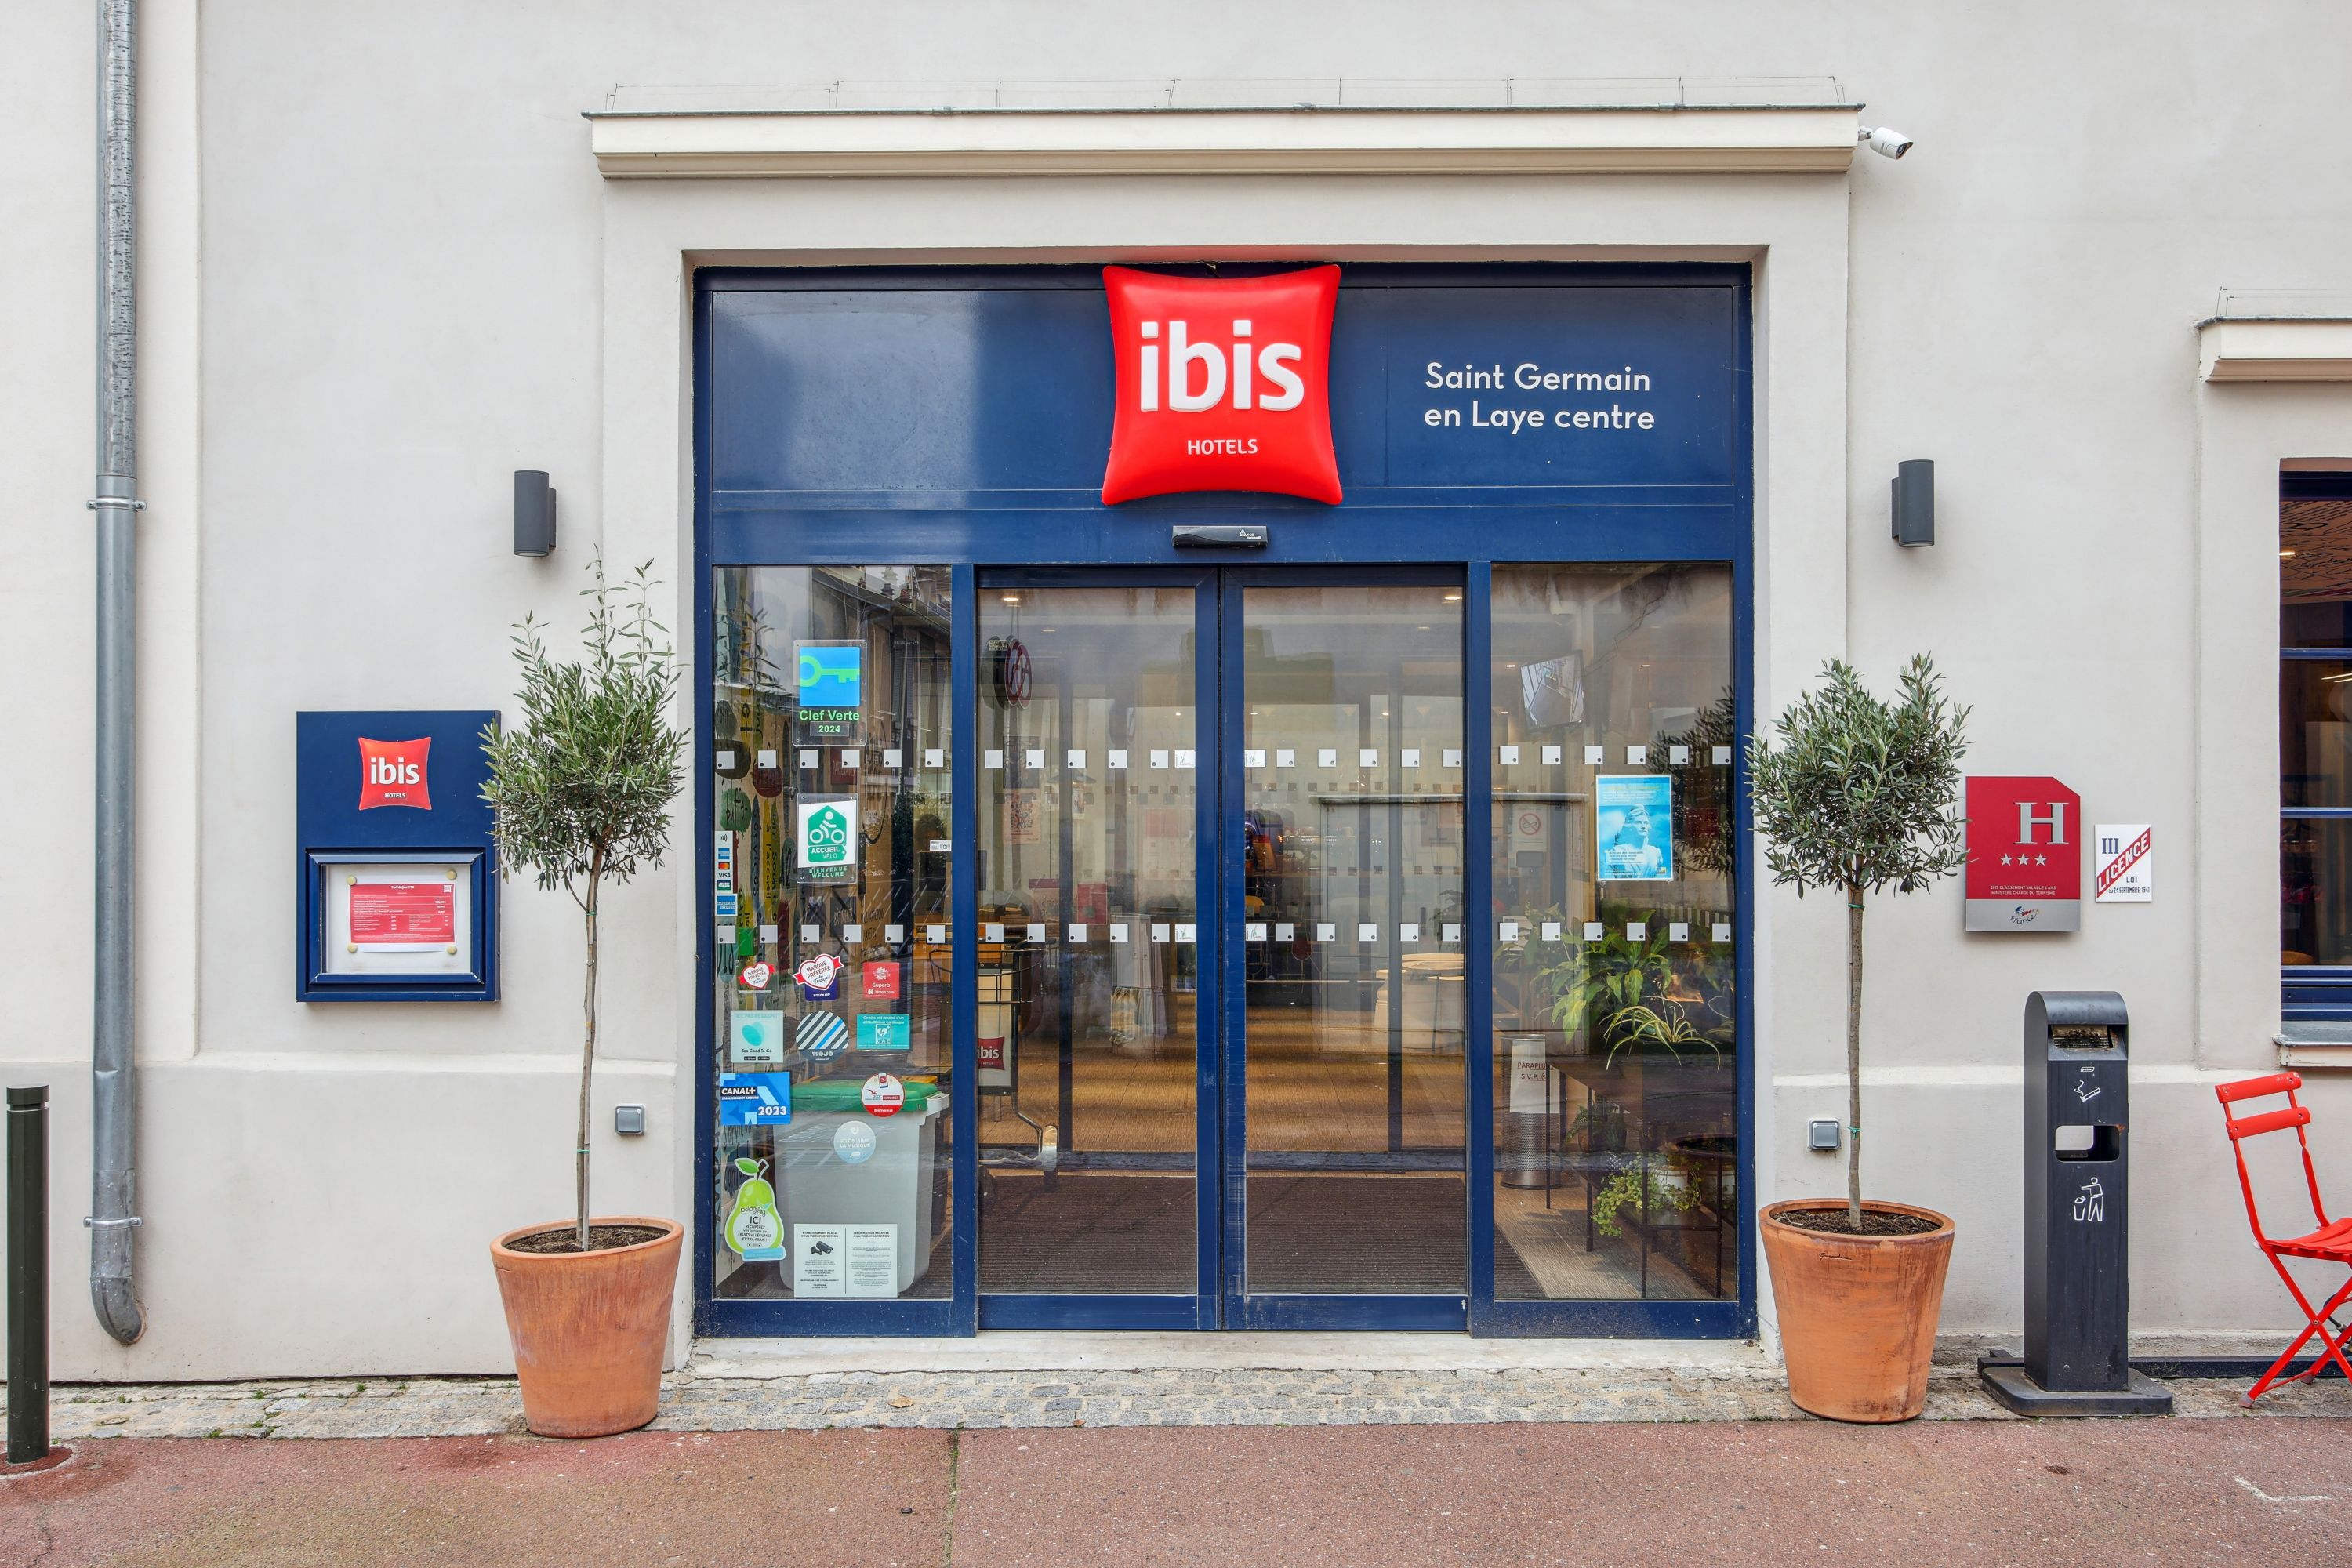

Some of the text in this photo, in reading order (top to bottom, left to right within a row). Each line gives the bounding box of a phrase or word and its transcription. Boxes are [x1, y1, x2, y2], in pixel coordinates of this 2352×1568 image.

[1140, 319, 1305, 413] ibis
[1425, 361, 1651, 392] Saint Germain
[1424, 400, 1655, 435] en Laye centre
[1187, 438, 1258, 455] HOTELS
[799, 710, 860, 721] Clef Verte
[818, 724, 841, 734] 2024
[370, 757, 420, 786] ibis
[2013, 801, 2071, 845] H
[811, 846, 840, 855] ACCUEIL
[2101, 837, 2119, 855] III
[2097, 832, 2149, 893] LICENCE
[808, 866, 848, 874] BIENVENUE
[747, 966, 764, 975] MARQUE
[806, 960, 828, 972] MARQUE
[807, 965, 832, 979] PRÉFÉRÉE
[721, 1087, 756, 1095] CANAL+
[757, 1105, 787, 1116] 2023
[750, 1216, 761, 1225] ICI
